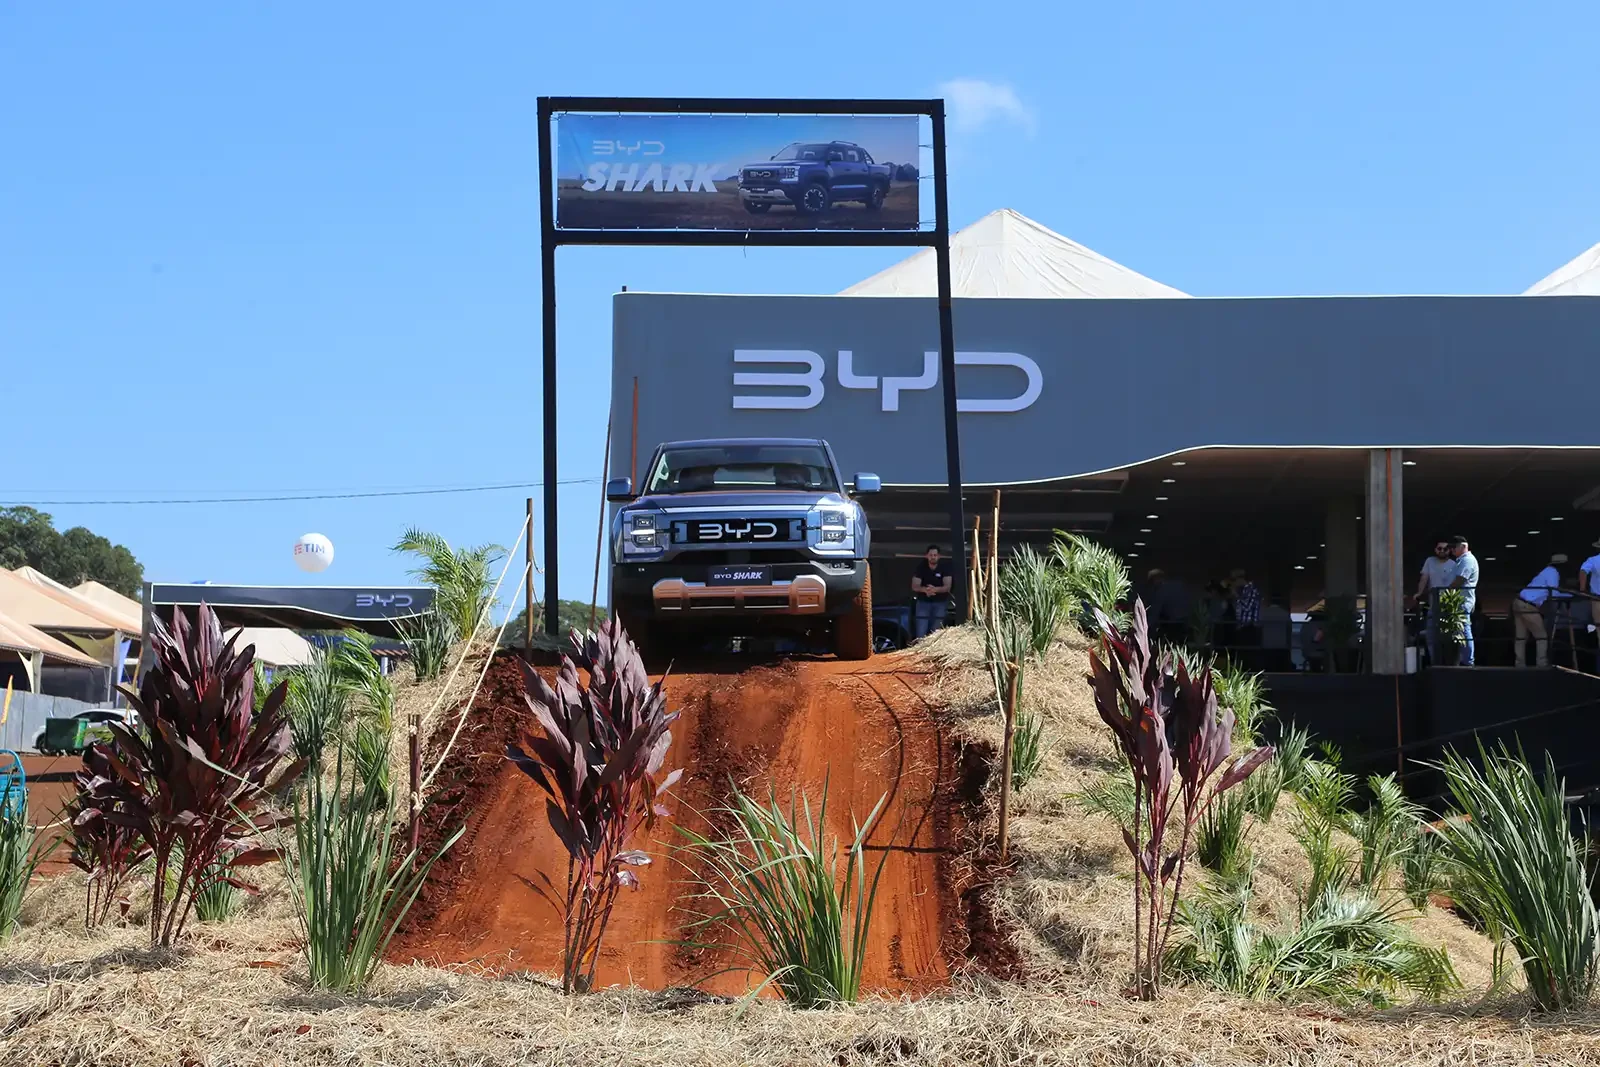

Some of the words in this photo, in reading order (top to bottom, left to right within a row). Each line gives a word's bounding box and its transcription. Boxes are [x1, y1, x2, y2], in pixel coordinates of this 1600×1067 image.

[593, 140, 665, 155] BYD
[582, 162, 725, 192] SHARK
[733, 349, 1043, 412] BYD
[698, 523, 777, 539] BYD
[304, 543, 325, 554] TIM
[733, 571, 763, 580] SHARK
[356, 594, 413, 607] BYD
